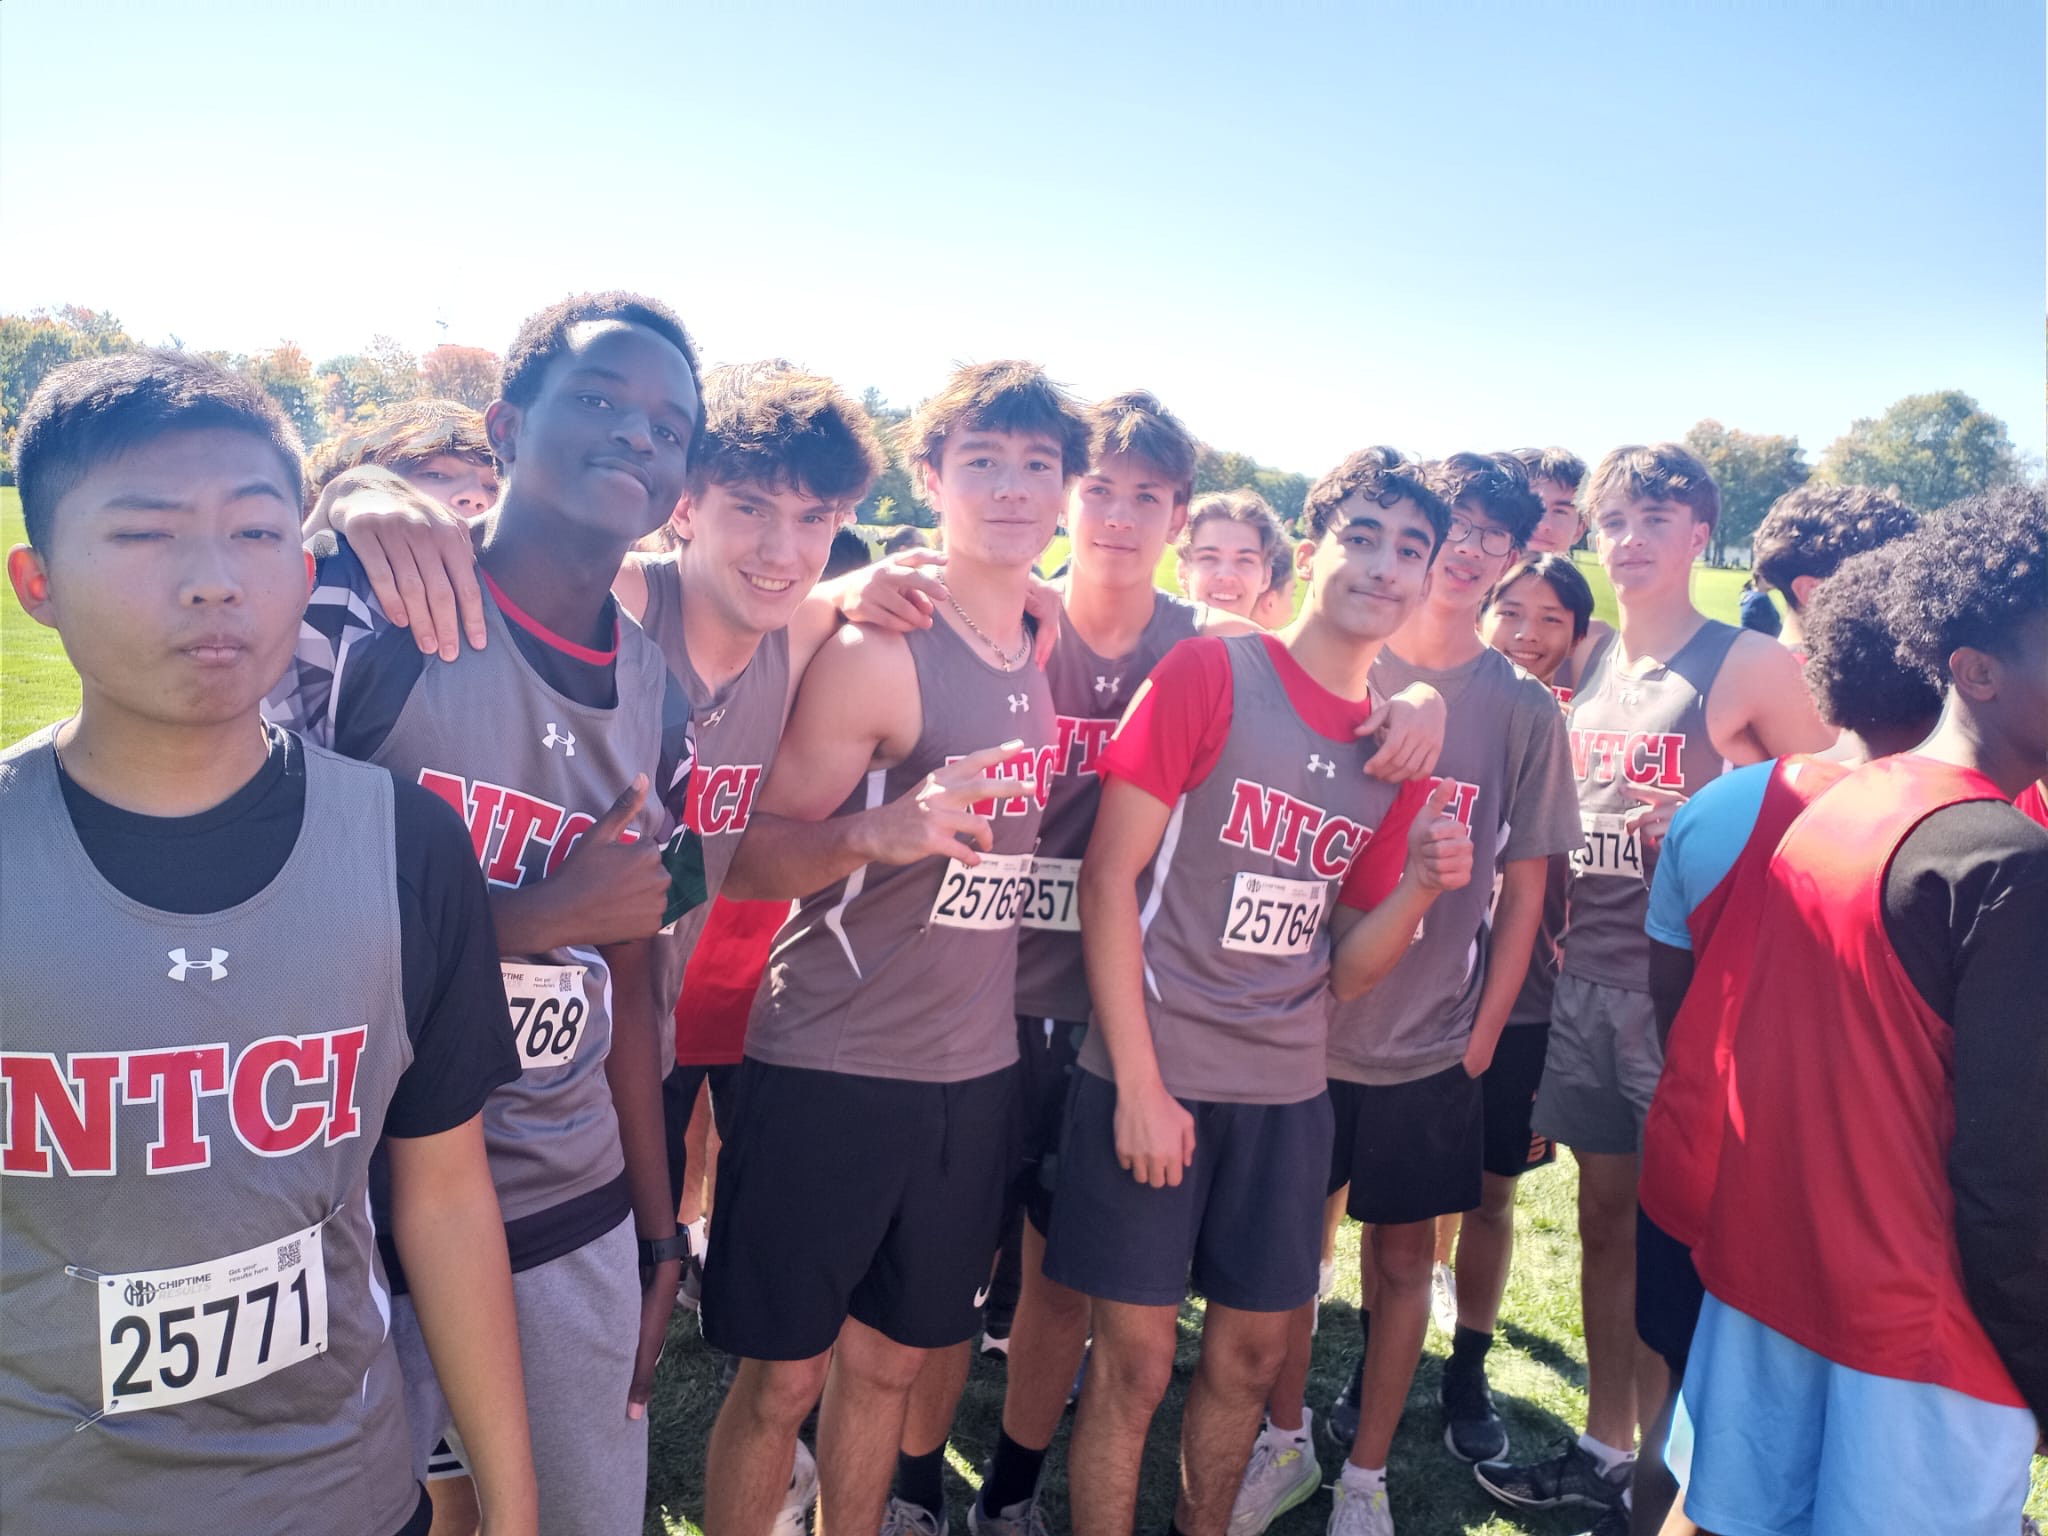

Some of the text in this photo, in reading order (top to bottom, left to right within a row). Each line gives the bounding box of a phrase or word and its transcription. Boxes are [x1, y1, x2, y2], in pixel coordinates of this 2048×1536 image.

[697, 764, 762, 836] CI
[945, 745, 1060, 820] TC
[417, 767, 641, 889] NT
[1020, 877, 1075, 922] 257
[1229, 896, 1320, 946] 25764
[510, 996, 583, 1058] 768
[0, 1024, 368, 1177] NTCI
[158, 1273, 212, 1290] CHIPTIME
[228, 1263, 257, 1276] Get your
[228, 1265, 269, 1284] results here
[110, 1268, 310, 1398] 25771
